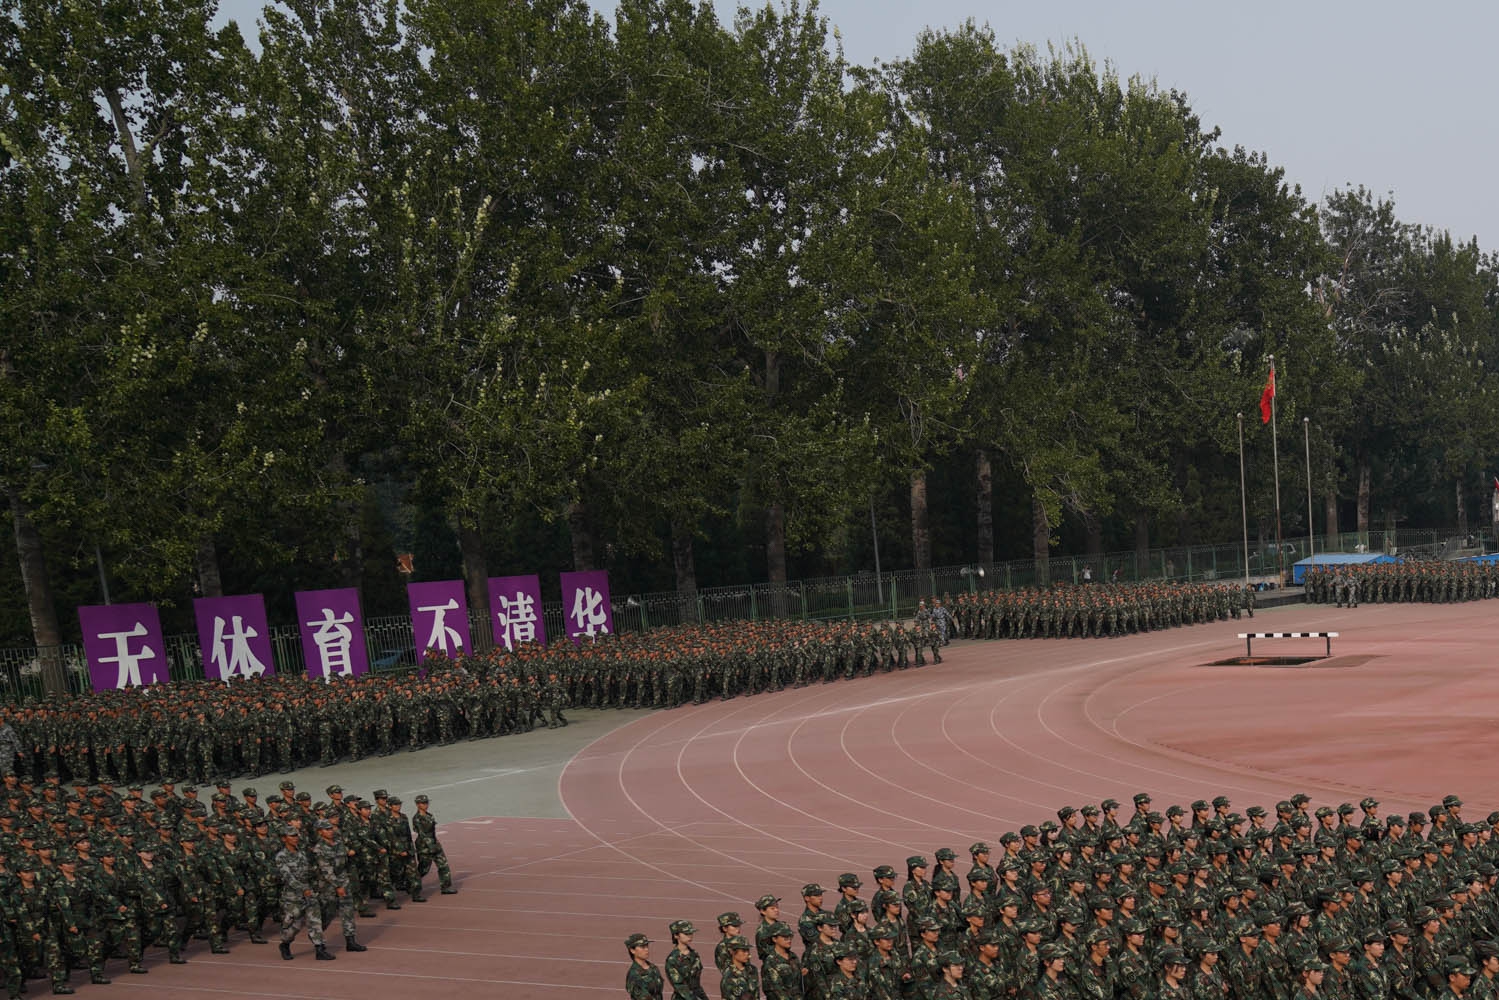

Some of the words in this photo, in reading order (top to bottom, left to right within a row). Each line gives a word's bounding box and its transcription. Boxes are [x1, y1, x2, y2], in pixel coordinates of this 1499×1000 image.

[306, 608, 354, 685] 育
[417, 598, 463, 656] 不
[497, 591, 538, 653] 清
[570, 586, 609, 644] 华
[97, 622, 158, 692] 无
[211, 615, 266, 688] 体
